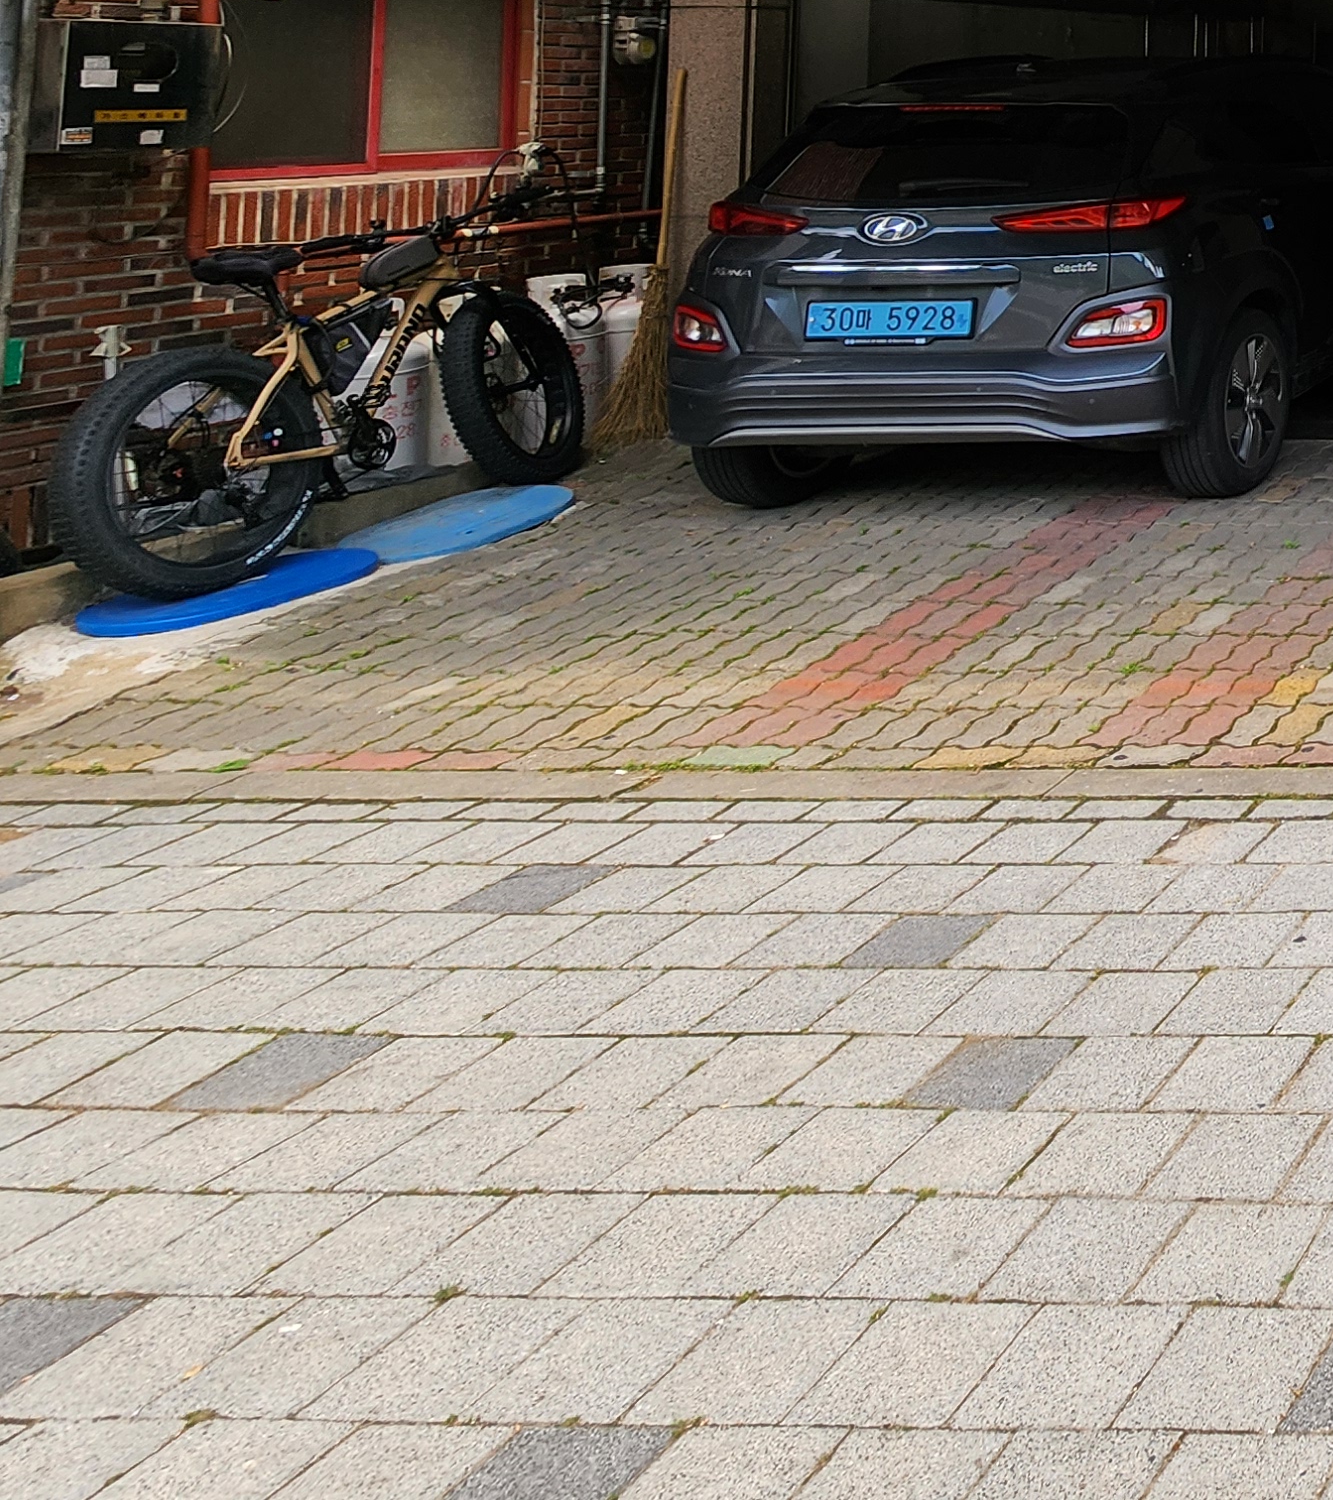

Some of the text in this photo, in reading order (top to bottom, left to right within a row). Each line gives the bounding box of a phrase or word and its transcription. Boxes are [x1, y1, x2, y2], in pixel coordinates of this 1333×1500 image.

[1053, 261, 1098, 273] electric
[821, 305, 956, 332] 30마 5928
